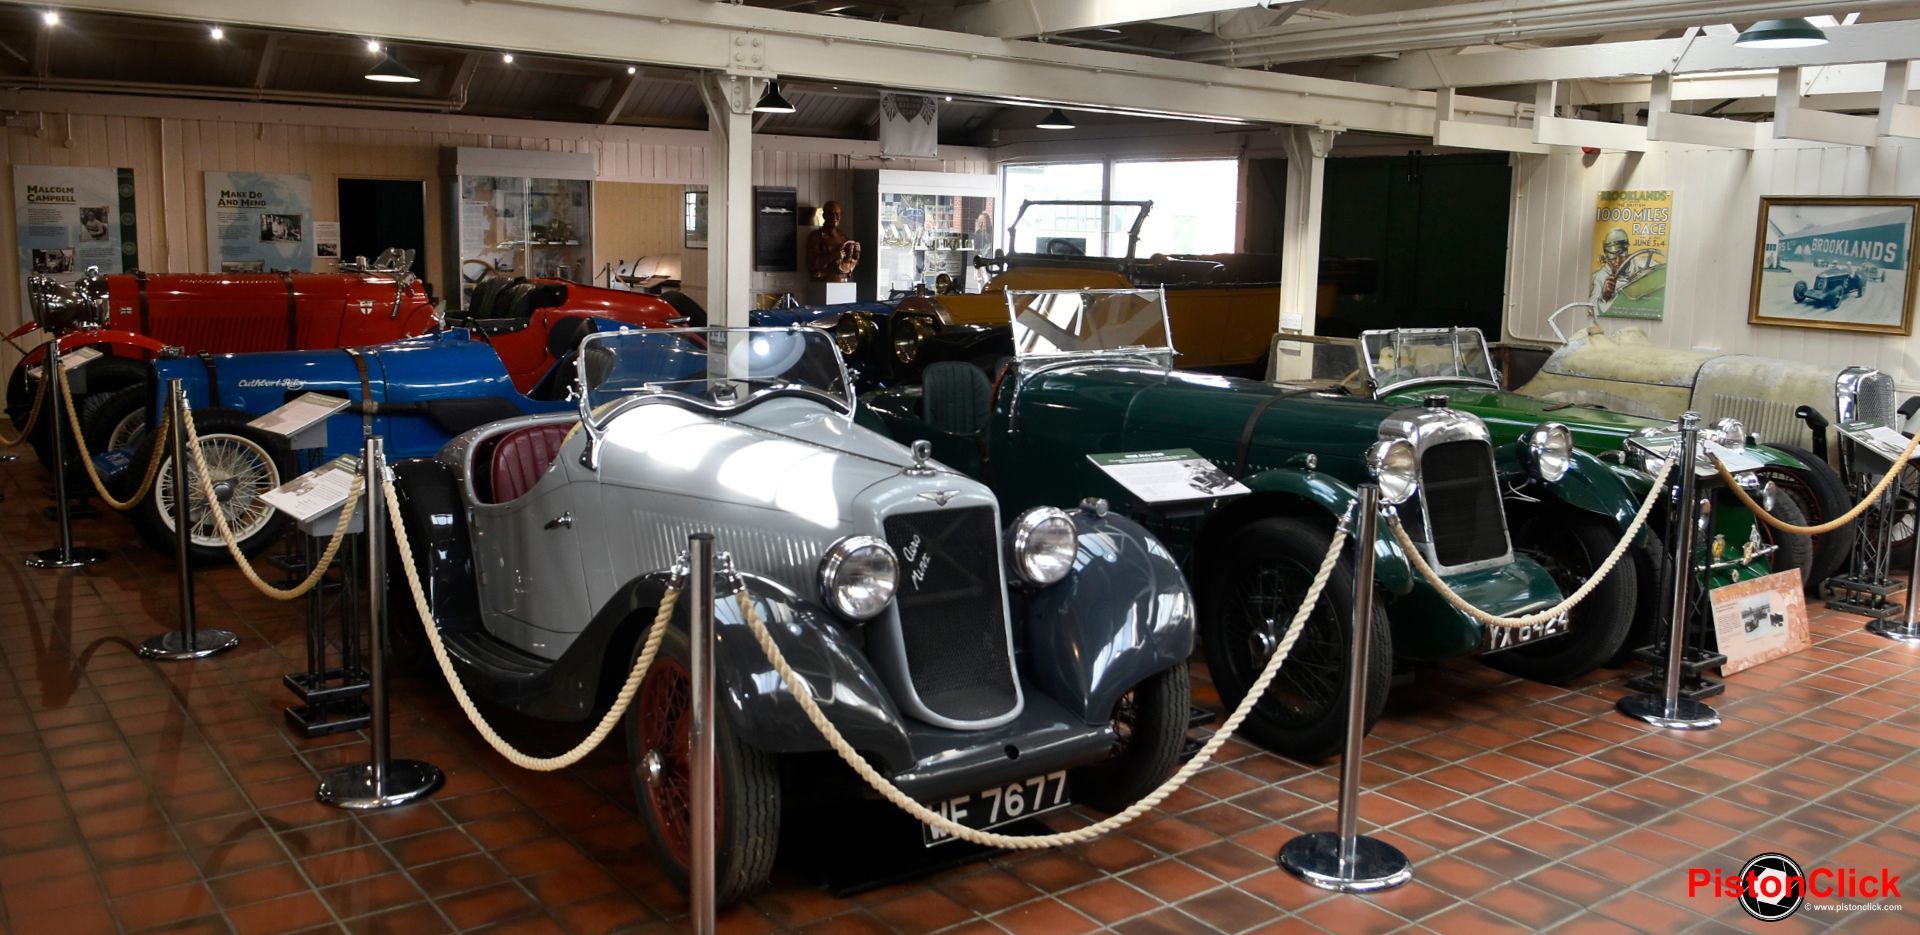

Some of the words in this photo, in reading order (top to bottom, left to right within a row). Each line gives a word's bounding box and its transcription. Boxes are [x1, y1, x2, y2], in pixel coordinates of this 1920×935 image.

[27, 185, 75, 194] MALCOLM
[220, 190, 246, 198] MAKE
[249, 191, 263, 199] DO
[27, 194, 76, 203] CAMPBELL
[1600, 190, 1667, 201] BROOKLANDS
[241, 199, 267, 207] MEND
[1596, 207, 1632, 222] 1000
[1633, 207, 1669, 222] MILES
[1632, 223, 1666, 235] RACE
[1811, 238, 1898, 262] BROOKLANDS
[981, 770, 1067, 824] 7677
